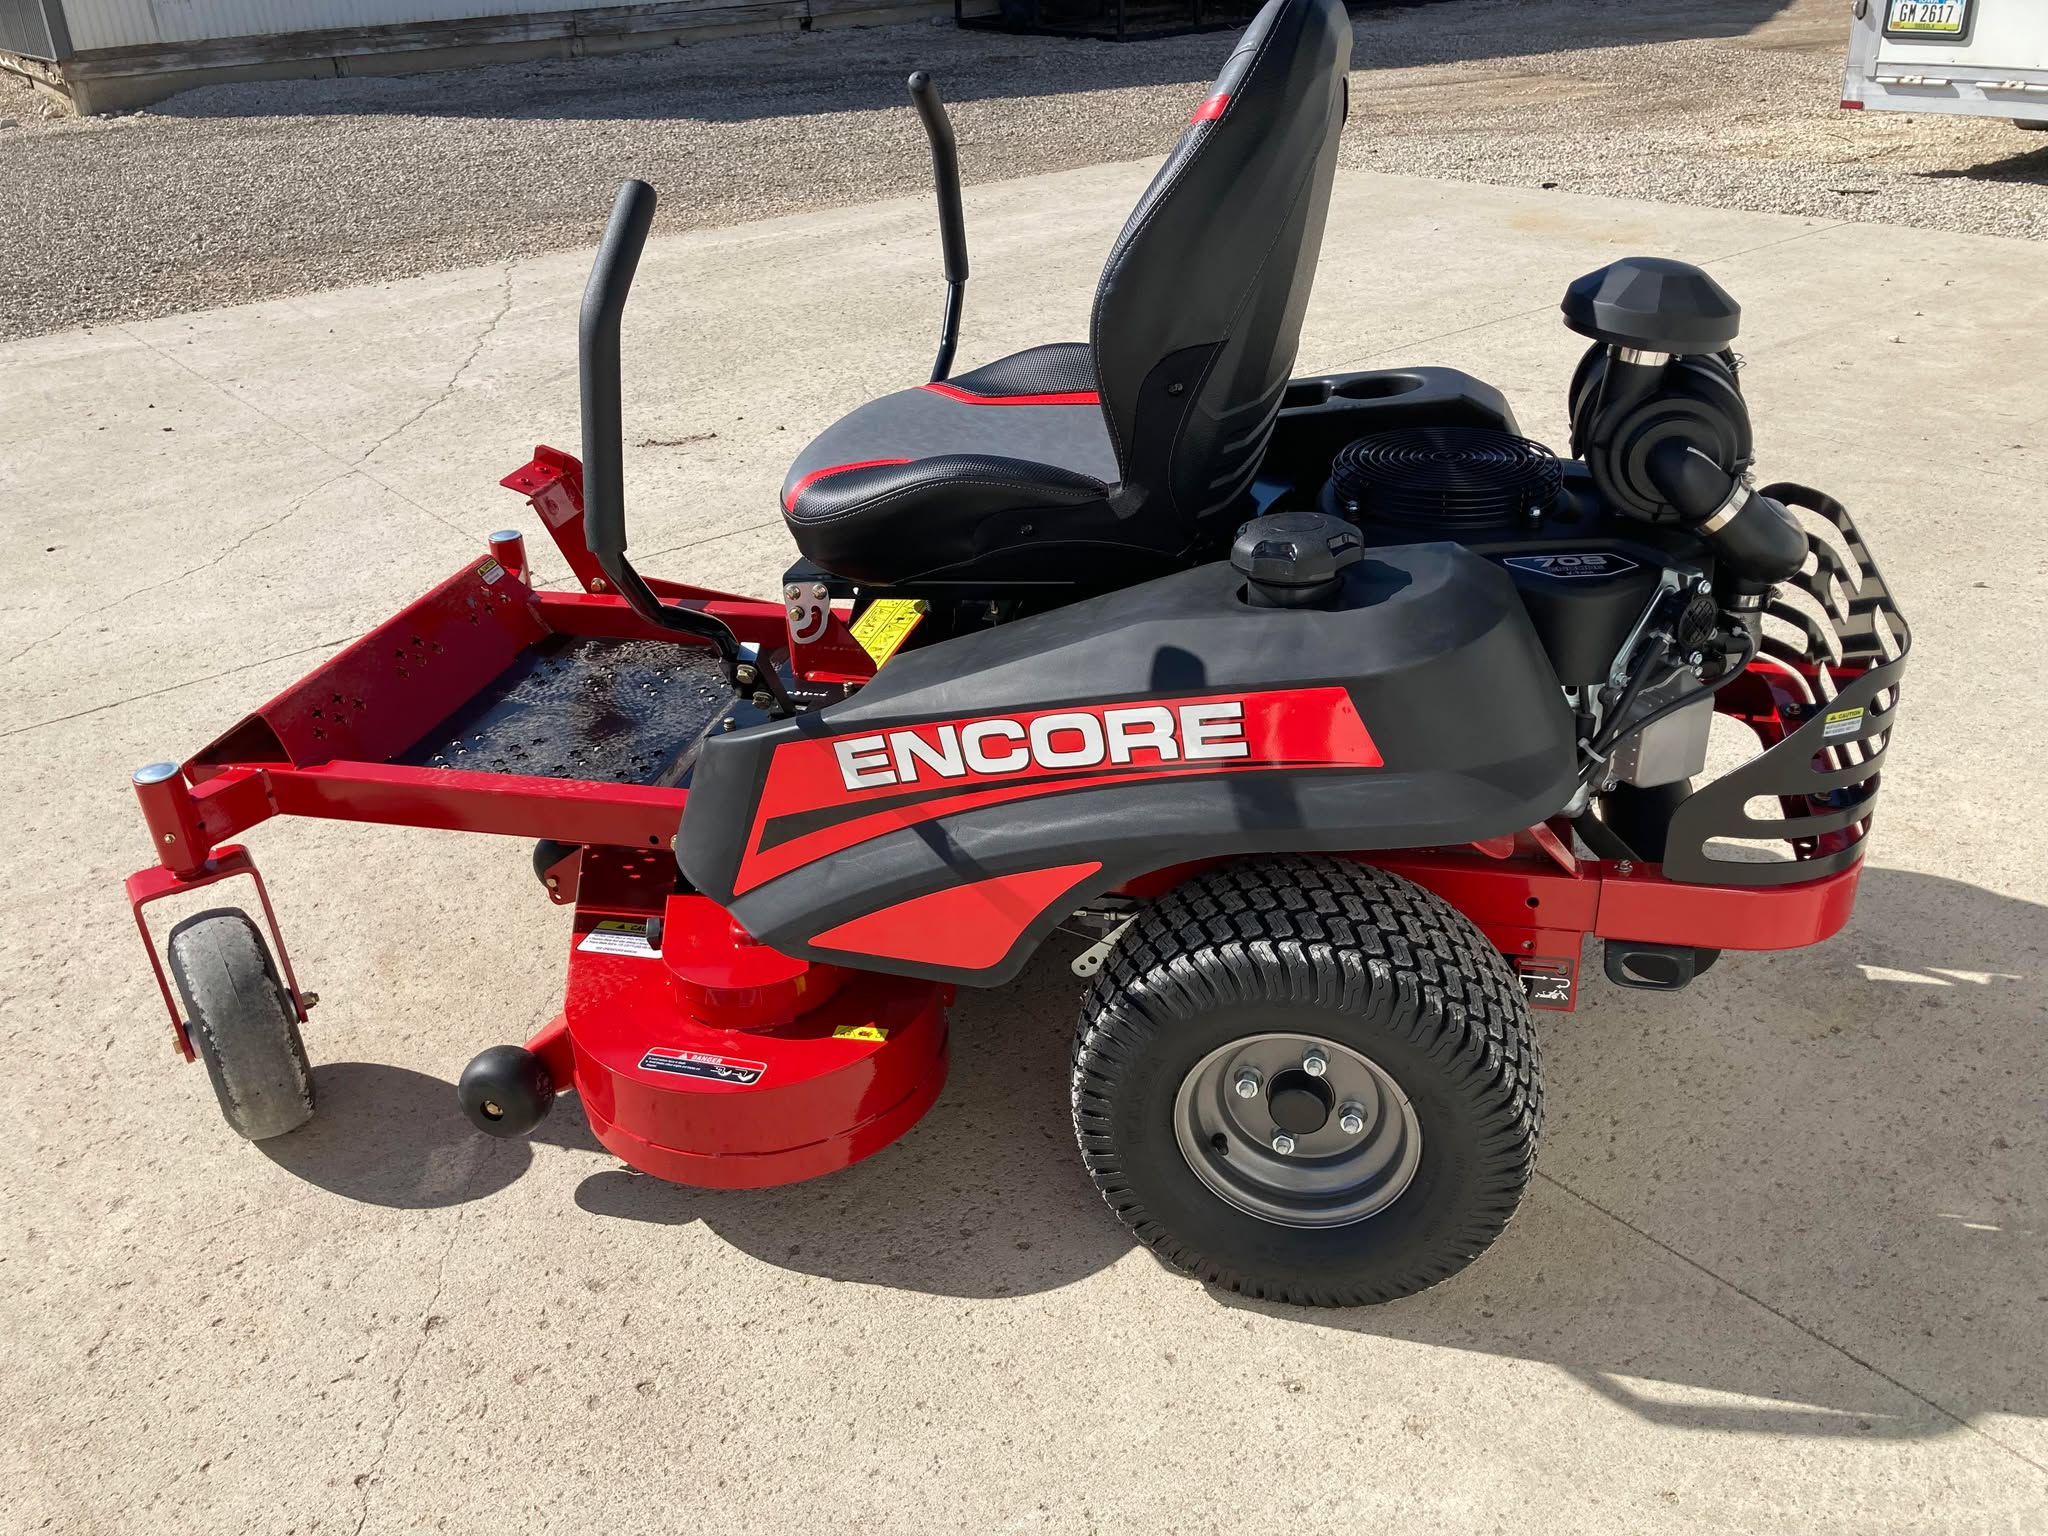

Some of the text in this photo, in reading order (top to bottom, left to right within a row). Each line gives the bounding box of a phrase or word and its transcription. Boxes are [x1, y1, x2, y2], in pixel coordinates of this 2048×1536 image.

[1899, 4, 1954, 22] GM 2617
[1534, 556, 1607, 567] 708
[833, 701, 1249, 791] ENCORE
[691, 1055, 723, 1064] DANGER
